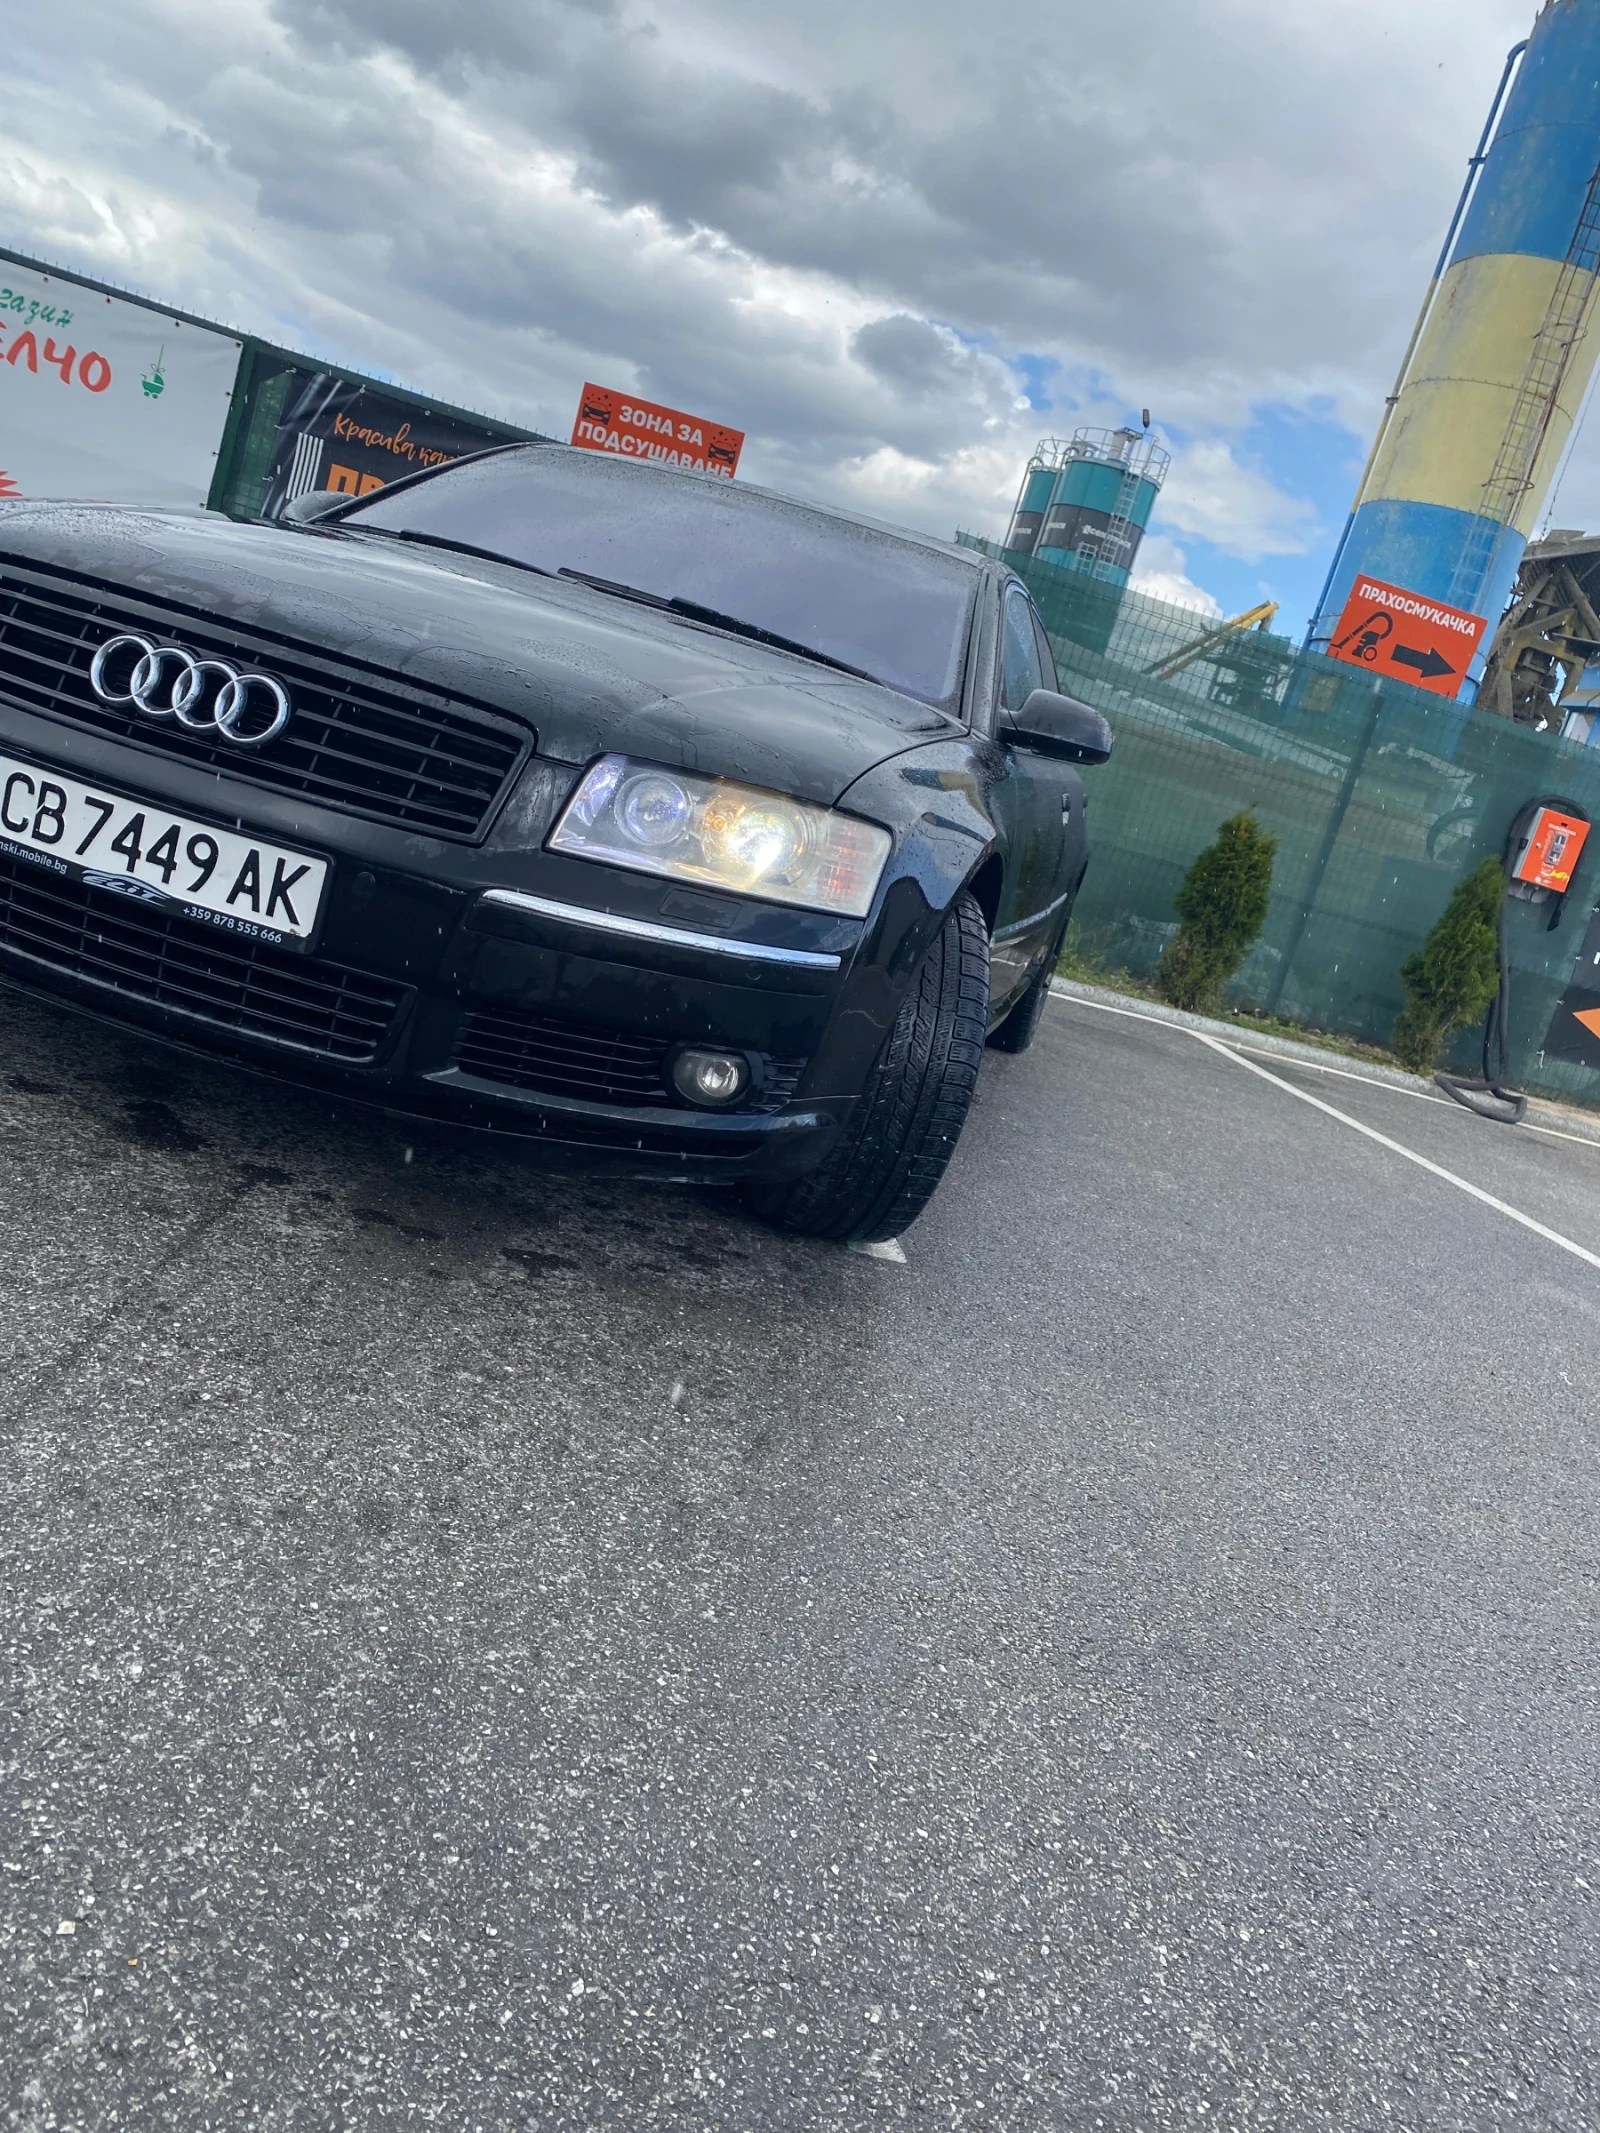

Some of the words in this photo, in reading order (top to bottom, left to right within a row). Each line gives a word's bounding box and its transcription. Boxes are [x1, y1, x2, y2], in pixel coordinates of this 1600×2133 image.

[0, 321, 111, 393] ЛЧО
[333, 412, 416, 461] Красива
[618, 405, 673, 437] ЗОНА
[677, 423, 703, 447] ЗА
[1358, 583, 1476, 637] ПРАХОСМУКАЧКА
[75, 795, 220, 893] 7449
[183, 906, 212, 922] +359
[212, 913, 235, 930] 878
[236, 920, 259, 937] 555
[260, 928, 283, 944] 666
